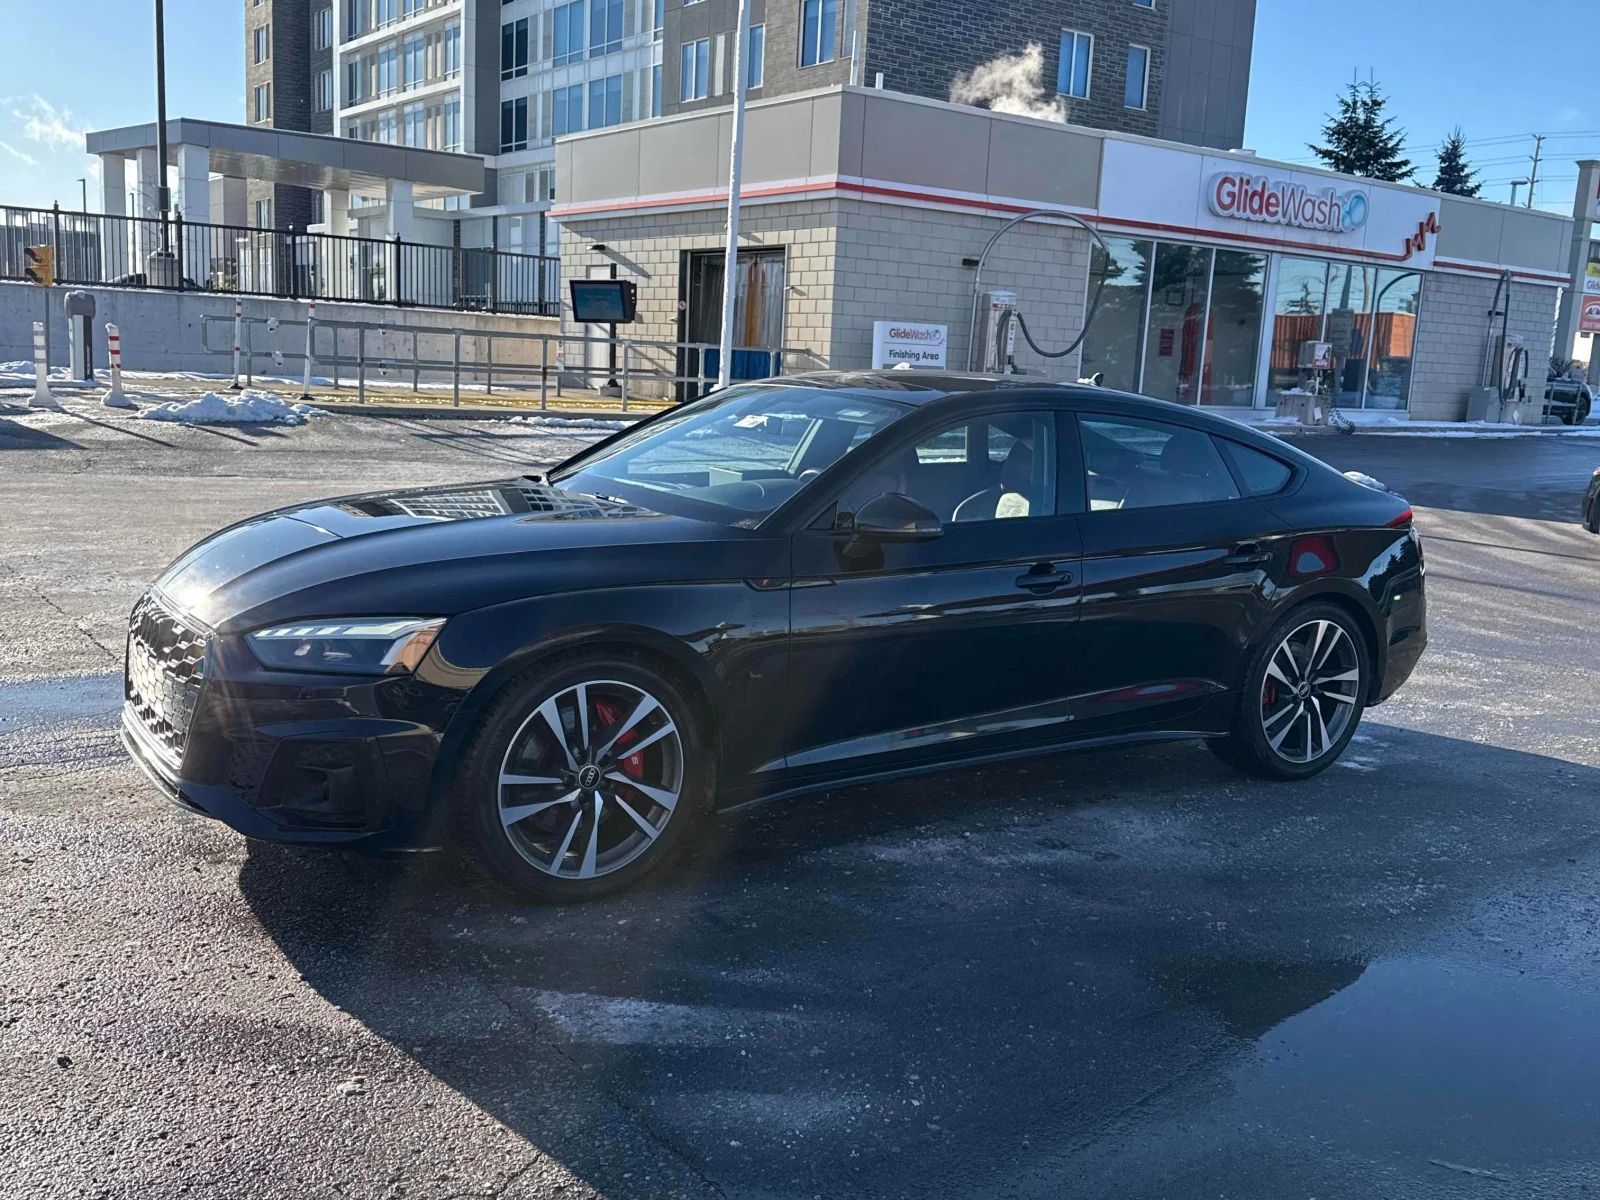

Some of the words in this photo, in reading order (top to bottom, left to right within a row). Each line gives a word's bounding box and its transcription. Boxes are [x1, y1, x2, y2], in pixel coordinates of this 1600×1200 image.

[1216, 176, 1341, 227] GlideWash
[889, 328, 932, 340] GlideWash
[889, 349, 920, 361] Finishing
[922, 351, 939, 360] Area
